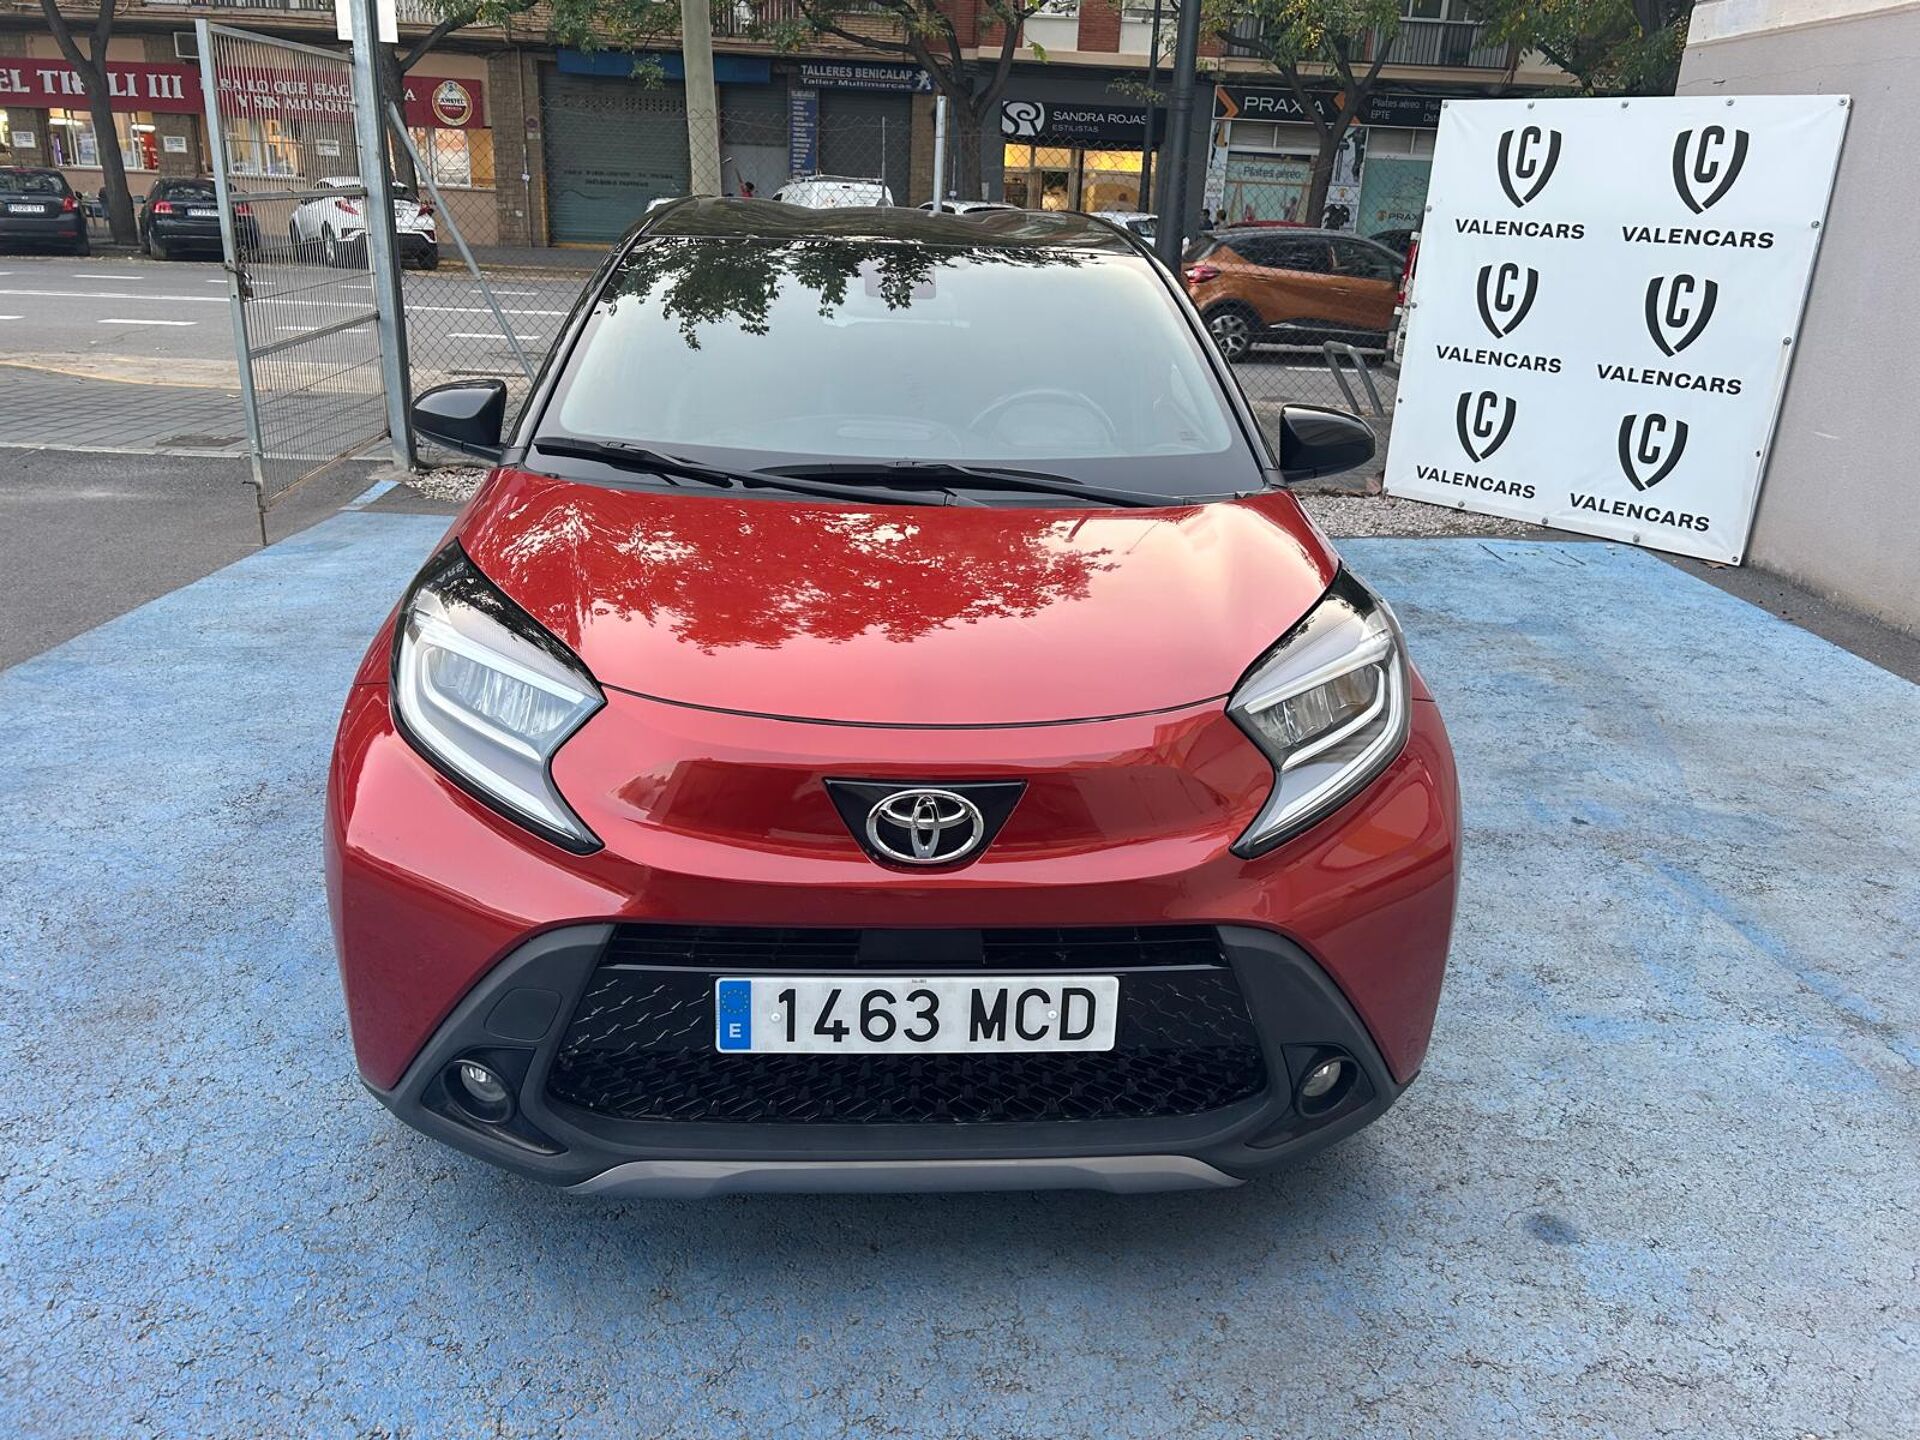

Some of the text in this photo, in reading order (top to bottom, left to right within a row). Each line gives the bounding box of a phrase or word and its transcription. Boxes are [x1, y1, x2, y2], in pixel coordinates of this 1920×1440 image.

[801, 65, 913, 80] TALLERES BENICALAP
[36, 69, 139, 97] TILI
[146, 74, 184, 98] III
[838, 80, 912, 89] Multimarcas
[1244, 97, 1325, 115] PRAXA
[1052, 111, 1147, 125] SANDRA ROJAS
[1052, 124, 1099, 133] ESTILISTAS
[1456, 219, 1584, 239] VALENCARS
[1623, 227, 1773, 248] VALENCARS
[1437, 346, 1561, 373] VALENCARS
[1598, 364, 1741, 395] VALENCARS
[1417, 466, 1535, 498] VALENCARS
[1571, 493, 1709, 531] VALENCARS
[778, 988, 940, 1043] 1463
[970, 988, 1096, 1042] MCD
[729, 1024, 741, 1038] E
